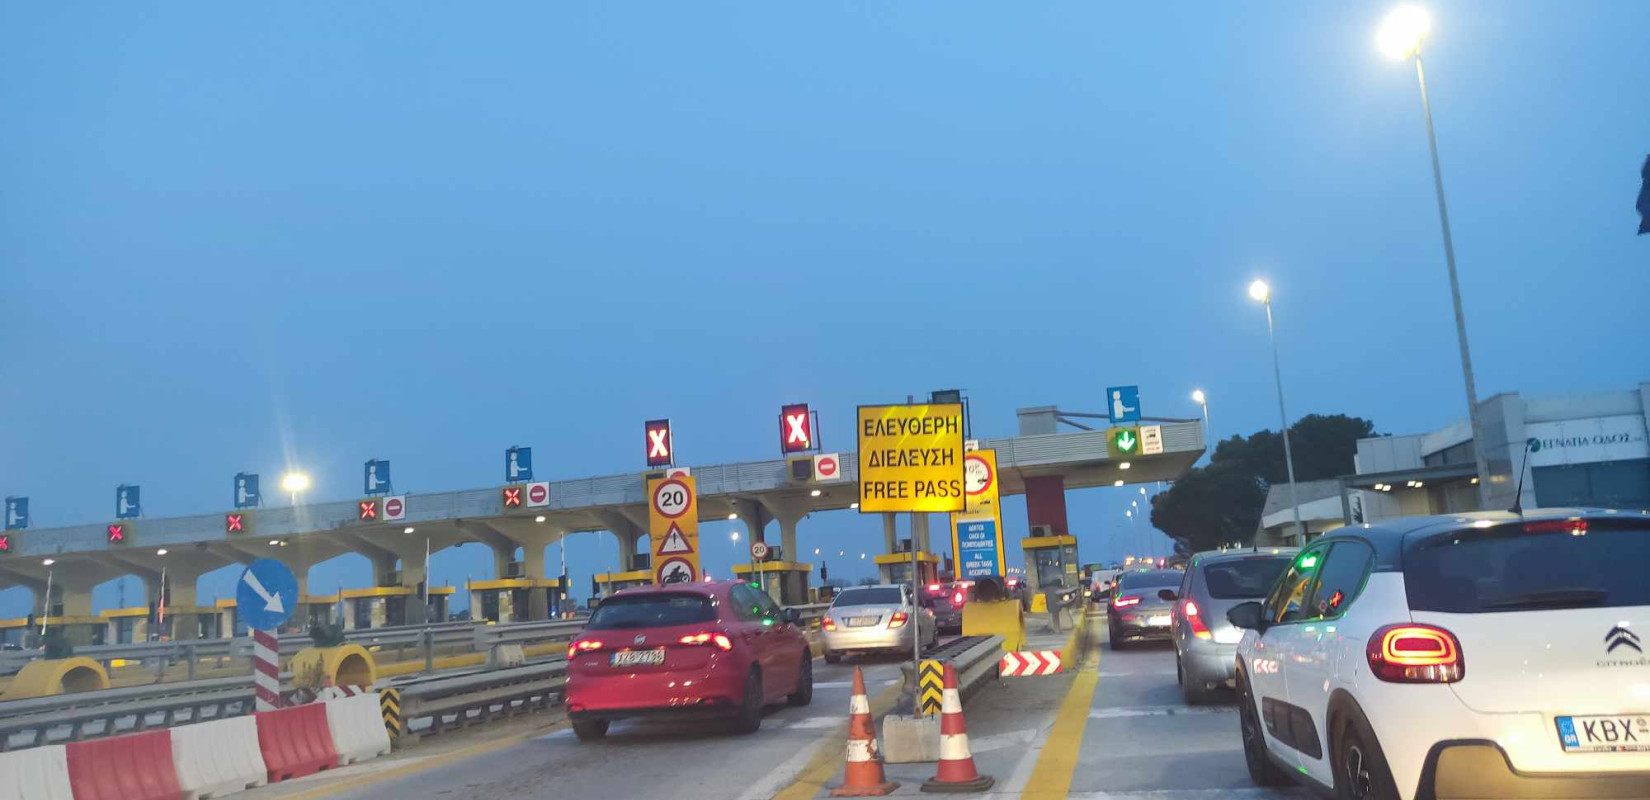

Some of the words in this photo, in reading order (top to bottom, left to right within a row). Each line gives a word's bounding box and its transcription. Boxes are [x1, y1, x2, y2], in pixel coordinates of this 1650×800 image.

[864, 416, 958, 437] ΕΛΕΥΘΕΡΗ
[869, 448, 954, 468] ΔΙΕΛΕΥΣΗ
[661, 490, 684, 507] 20
[864, 481, 909, 499] FREE
[915, 480, 961, 498] PASS
[754, 545, 765, 554] 20
